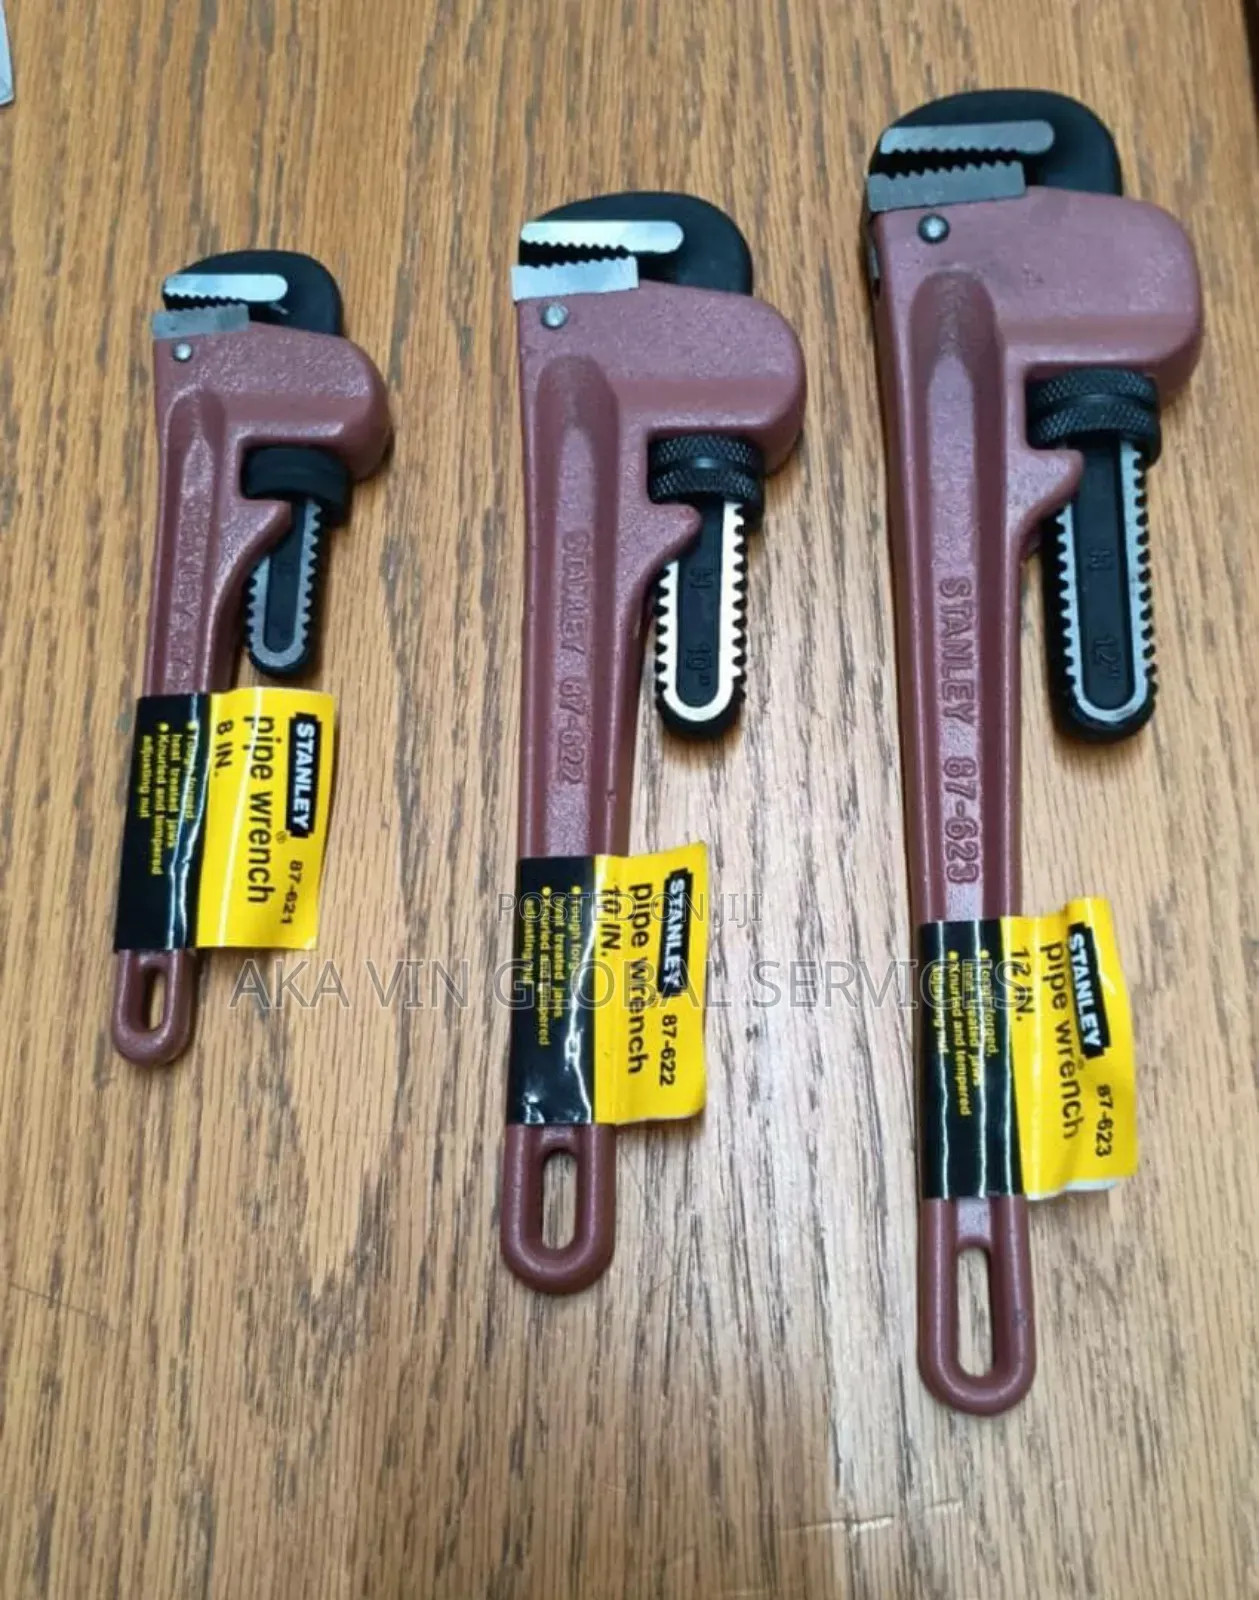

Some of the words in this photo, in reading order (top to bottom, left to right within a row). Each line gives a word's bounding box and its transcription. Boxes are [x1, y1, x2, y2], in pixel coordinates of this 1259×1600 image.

[940, 577, 976, 727] STANLEY
[156, 734, 168, 785] Knurled
[214, 742, 233, 777] IN.
[216, 720, 233, 735] 8
[242, 716, 282, 781] pipe
[138, 735, 153, 794] adjusting
[167, 768, 180, 812] treated
[291, 722, 315, 830] STANLEY
[140, 797, 151, 818] nut
[155, 788, 166, 811] and
[943, 756, 979, 885] 87-623
[151, 815, 165, 875] tempered
[248, 792, 276, 903] wrench
[280, 860, 304, 925] 87-621
[602, 886, 621, 912] 10
[628, 883, 658, 948] pipe
[553, 934, 565, 980] treated
[601, 923, 620, 957] IN.
[662, 878, 686, 989] STANLEY
[1011, 947, 1032, 978] 12
[1015, 986, 1034, 1022] IN.
[1040, 942, 1071, 1010] pipe
[1068, 933, 1101, 1046] STANLEY
[628, 960, 649, 1074] wrench
[954, 1021, 966, 1046] and
[659, 1015, 677, 1087] 87-622
[955, 1050, 971, 1116] tempered
[1055, 1021, 1083, 1139] wrench
[1095, 1084, 1113, 1157] 87-623
